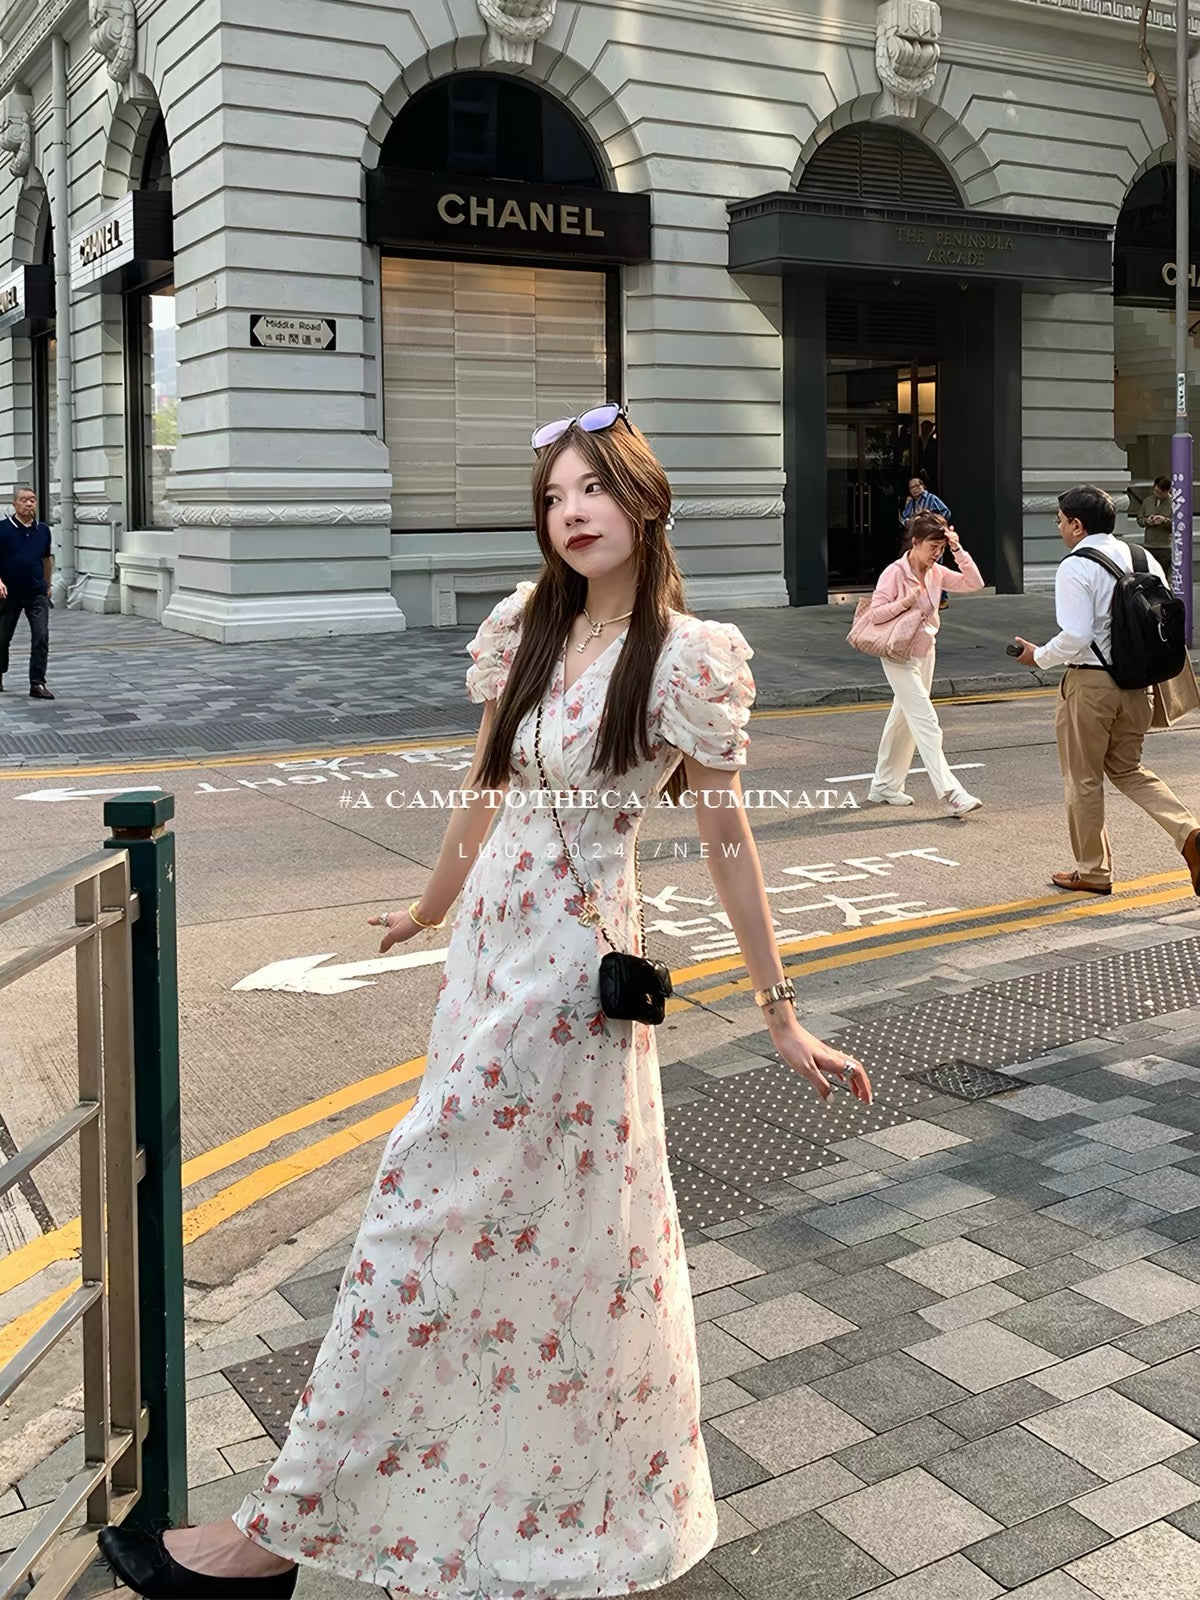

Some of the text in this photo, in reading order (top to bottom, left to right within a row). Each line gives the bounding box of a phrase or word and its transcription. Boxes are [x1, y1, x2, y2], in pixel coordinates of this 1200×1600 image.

[437, 193, 605, 238] CHANEL
[80, 220, 122, 266] CHANEL
[895, 227, 1015, 251] THE PENINSULA
[926, 249, 985, 265] ARCADE
[1161, 262, 1200, 287] CH
[266, 319, 322, 331] Middle Road
[194, 768, 400, 794] RIGHT
